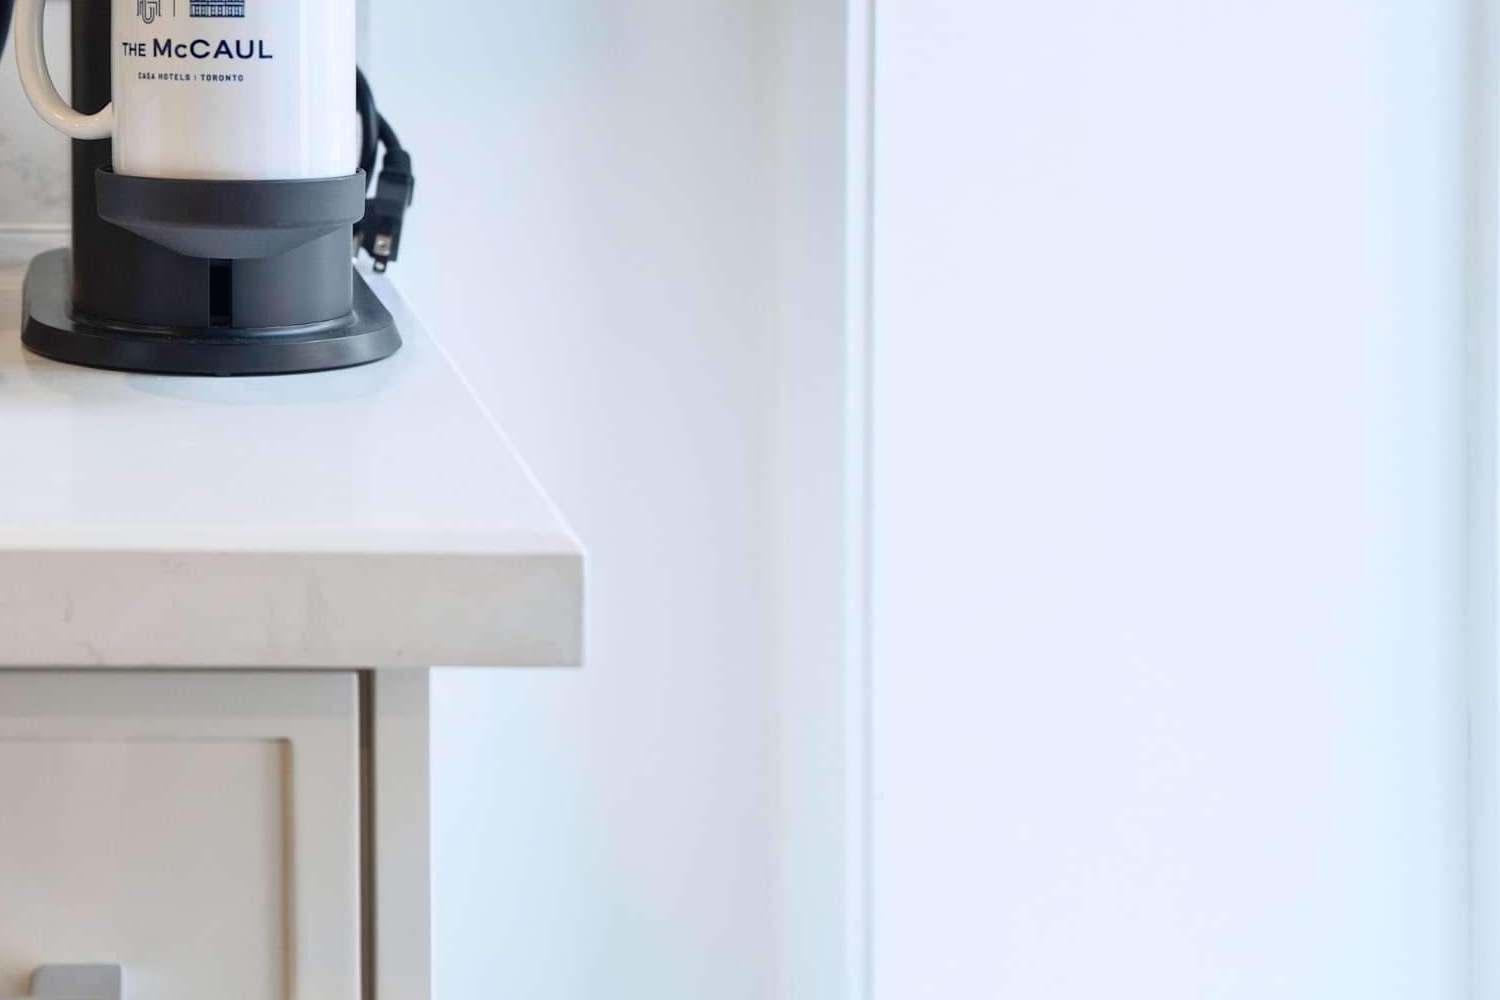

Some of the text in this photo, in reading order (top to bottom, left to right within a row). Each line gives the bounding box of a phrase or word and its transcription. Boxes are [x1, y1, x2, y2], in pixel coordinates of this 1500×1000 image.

[122, 38, 273, 59] THE McCAUL
[138, 72, 244, 82] CASA HOTELS TORONTO
